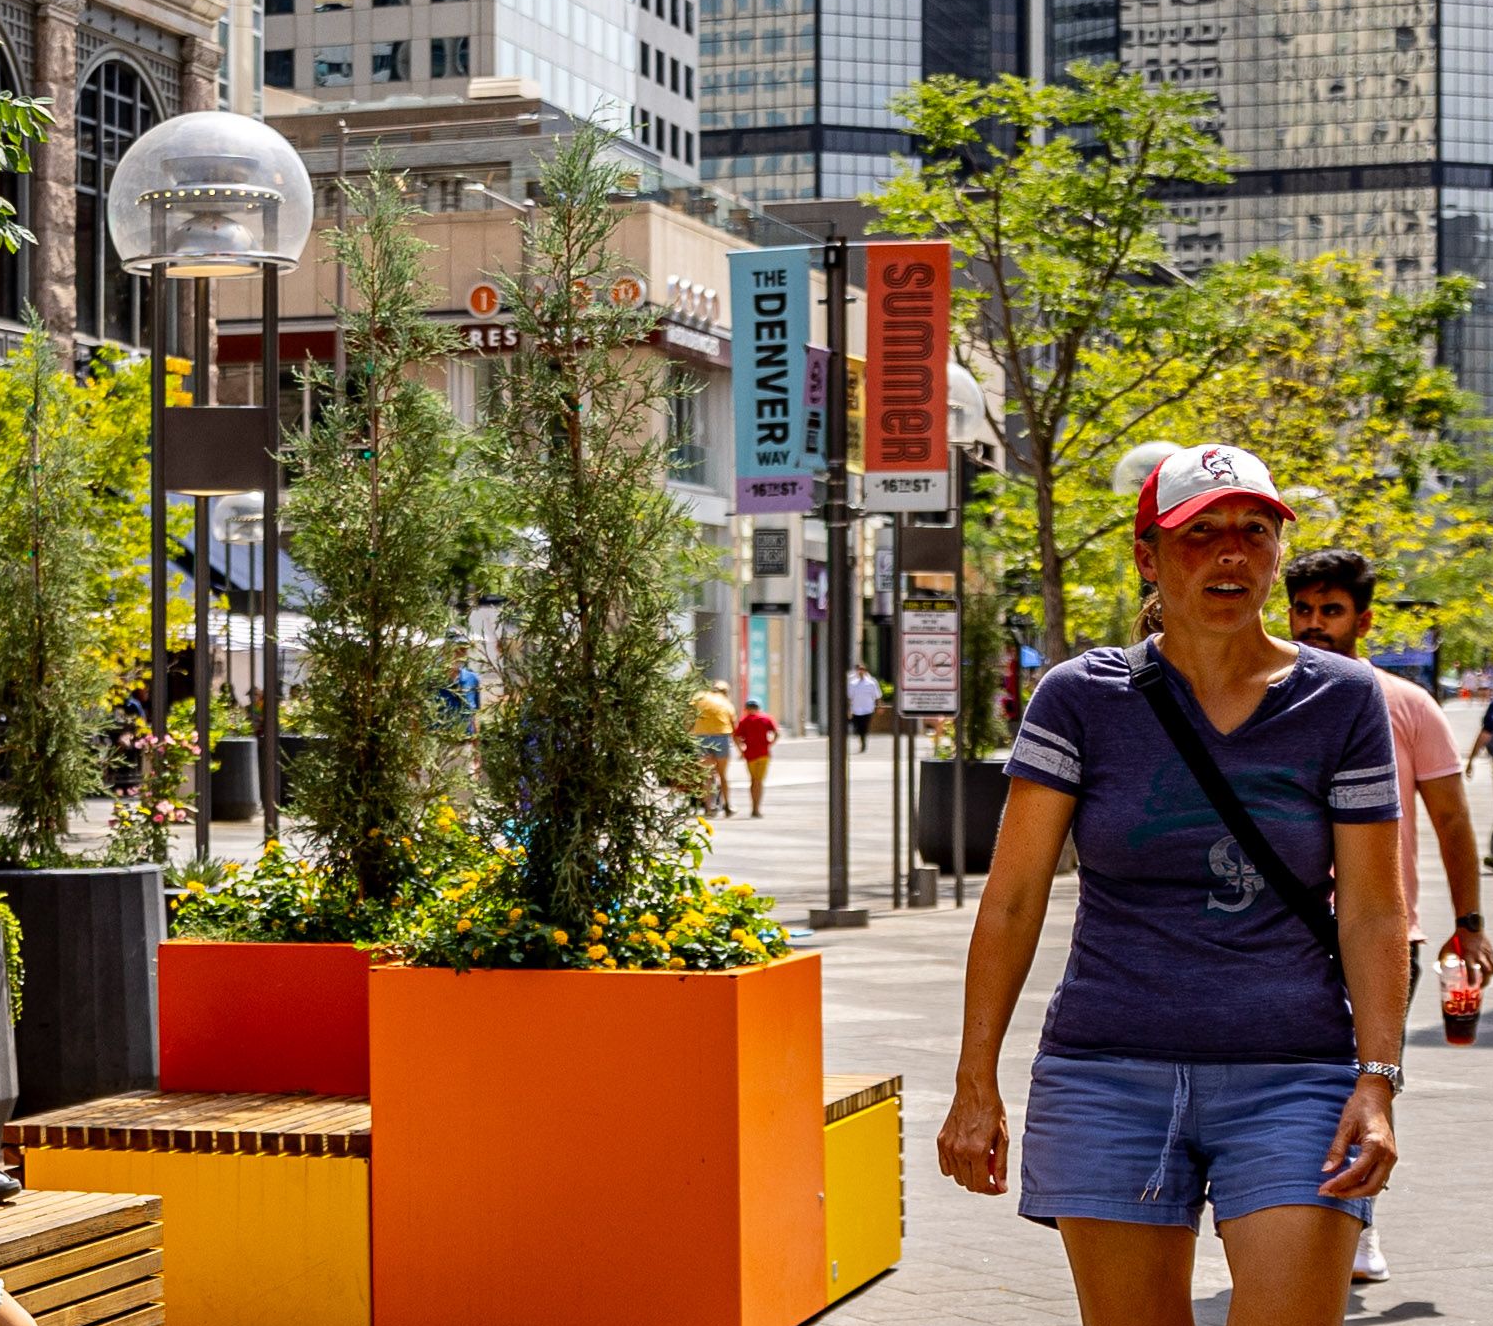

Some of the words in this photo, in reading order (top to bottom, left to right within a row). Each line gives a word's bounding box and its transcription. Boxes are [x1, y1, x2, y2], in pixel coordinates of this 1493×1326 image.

[753, 269, 787, 288] THE
[754, 293, 790, 447] DENVER
[757, 450, 791, 467] WAY
